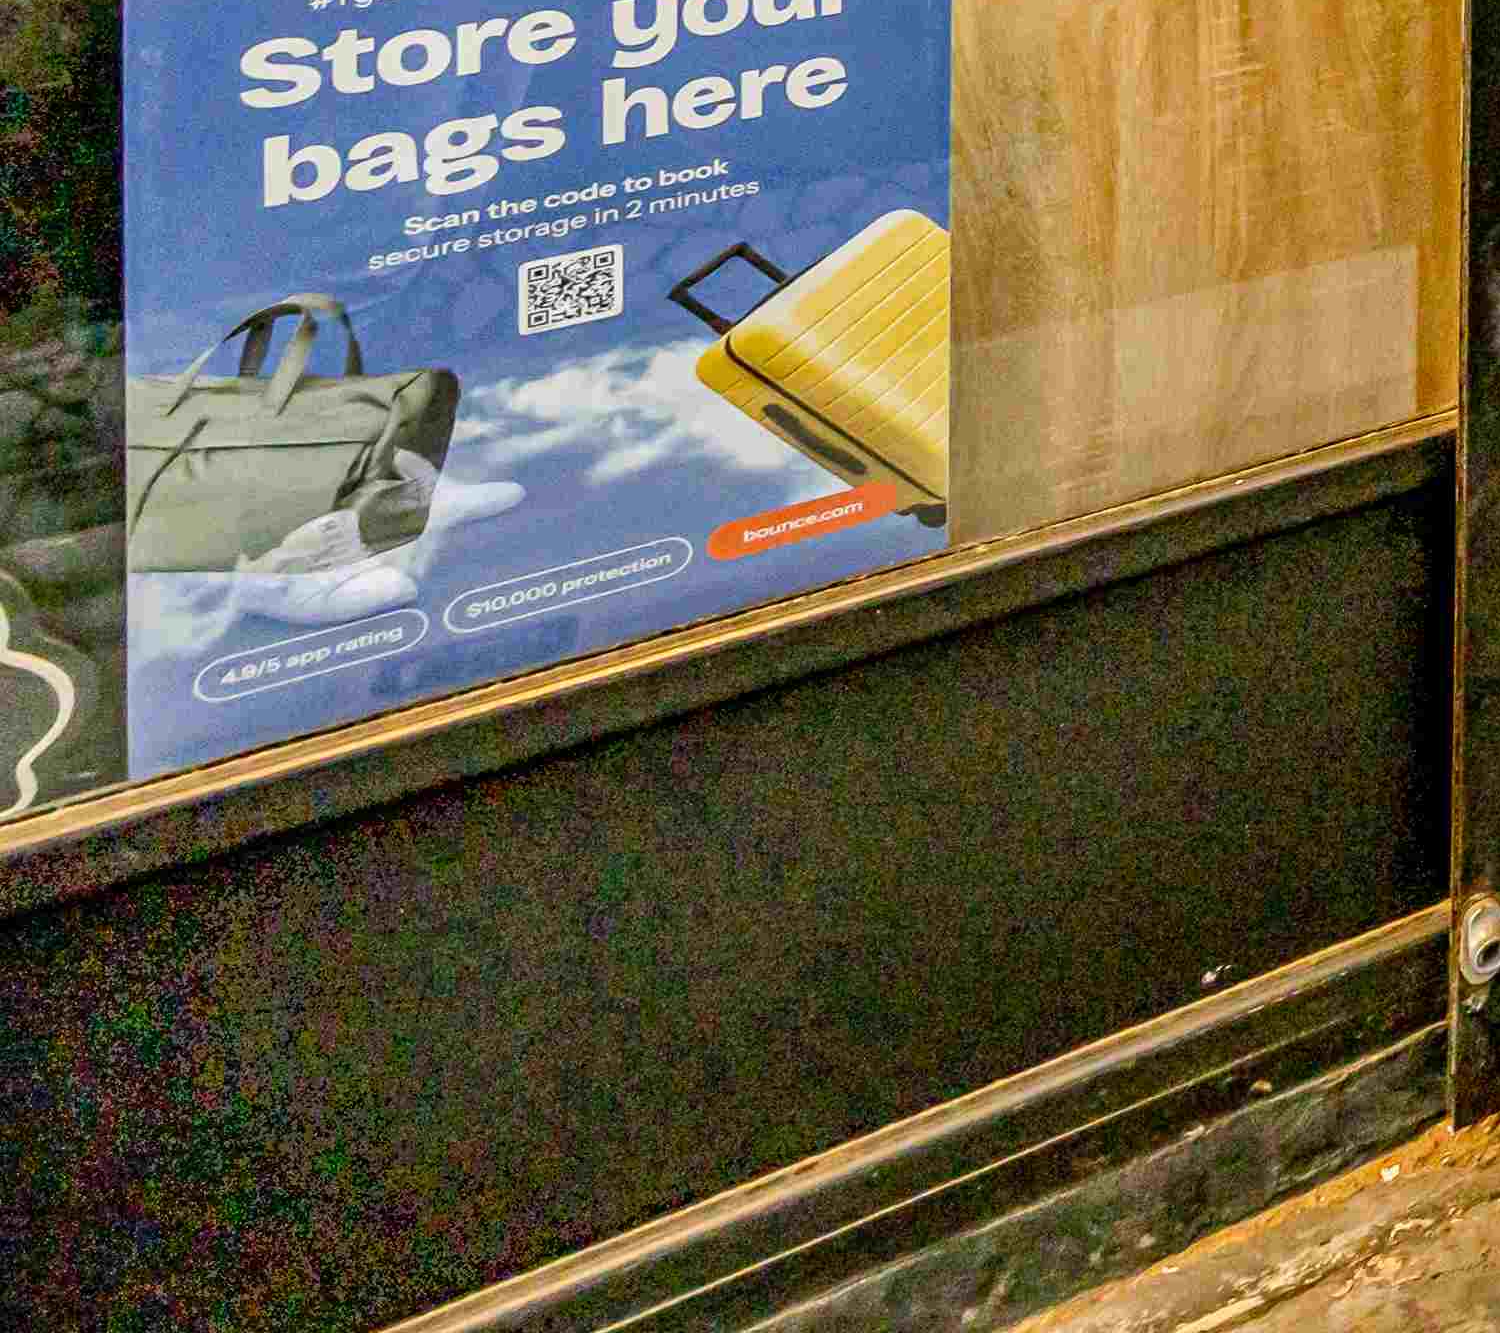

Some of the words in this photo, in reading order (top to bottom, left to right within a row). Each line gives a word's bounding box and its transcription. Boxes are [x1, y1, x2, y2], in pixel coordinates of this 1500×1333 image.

[239, 9, 577, 109] Store
[263, 104, 566, 208] bags
[601, 56, 850, 146] here
[368, 238, 472, 271] secure
[477, 215, 587, 251] storage
[593, 205, 619, 226] in
[624, 200, 643, 220] 2
[648, 178, 760, 214] minutes
[403, 206, 481, 236] Scan
[487, 194, 537, 220] the
[543, 179, 617, 210] code
[623, 174, 653, 195] to
[657, 157, 730, 188] book
[743, 500, 864, 544] bounce.com
[561, 551, 673, 595] protection
[285, 645, 331, 669] app
[334, 626, 404, 654] rating
